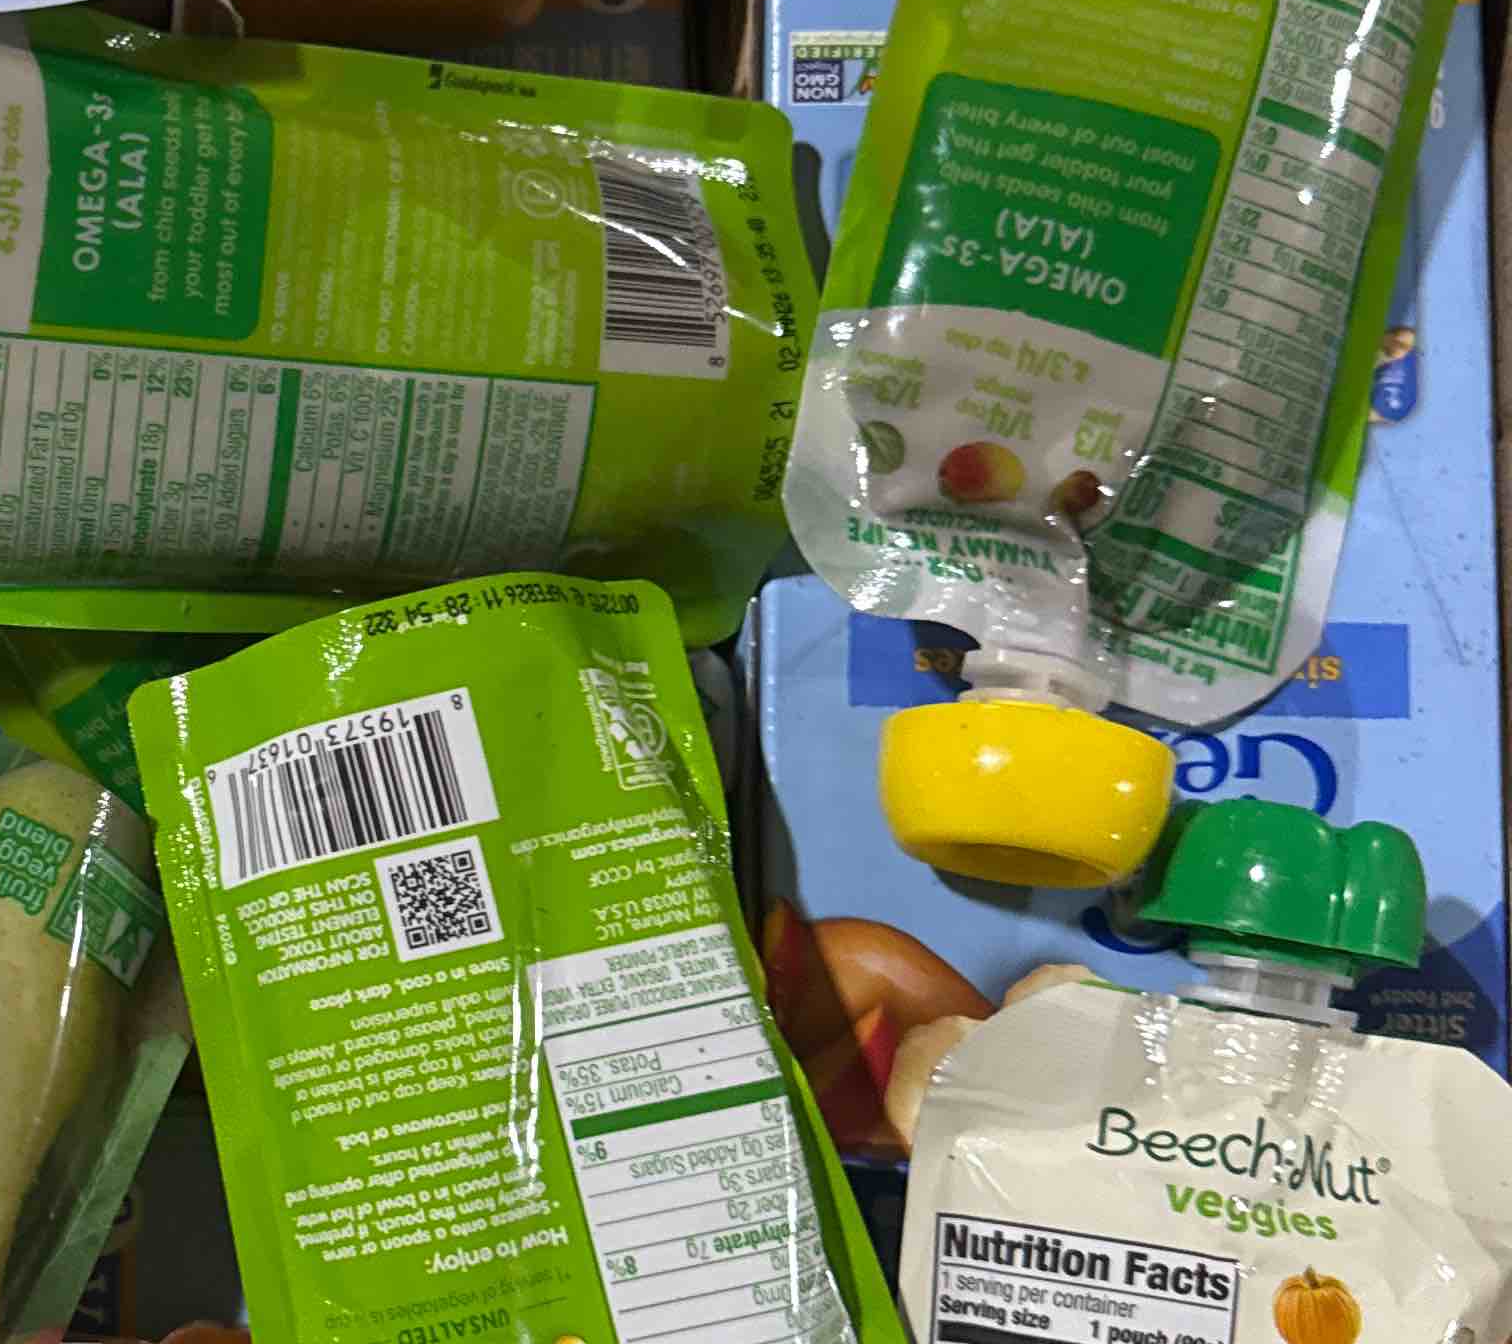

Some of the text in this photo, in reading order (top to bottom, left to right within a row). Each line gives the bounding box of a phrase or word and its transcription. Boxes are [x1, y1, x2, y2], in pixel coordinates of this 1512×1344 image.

[112, 130, 150, 231] (ALA)
[182, 122, 217, 299] your toddler get
[211, 125, 248, 315] most out of every
[1163, 1180, 1340, 1244] veggies
[941, 1222, 1232, 1301] Nutrition Facts
[953, 1273, 1013, 1305] serving
[1017, 1284, 1048, 1308] per
[1051, 1290, 1137, 1319] container
[938, 1293, 1007, 1328] Serving
[1012, 1306, 1051, 1330] size
[1088, 1319, 1101, 1339] 1
